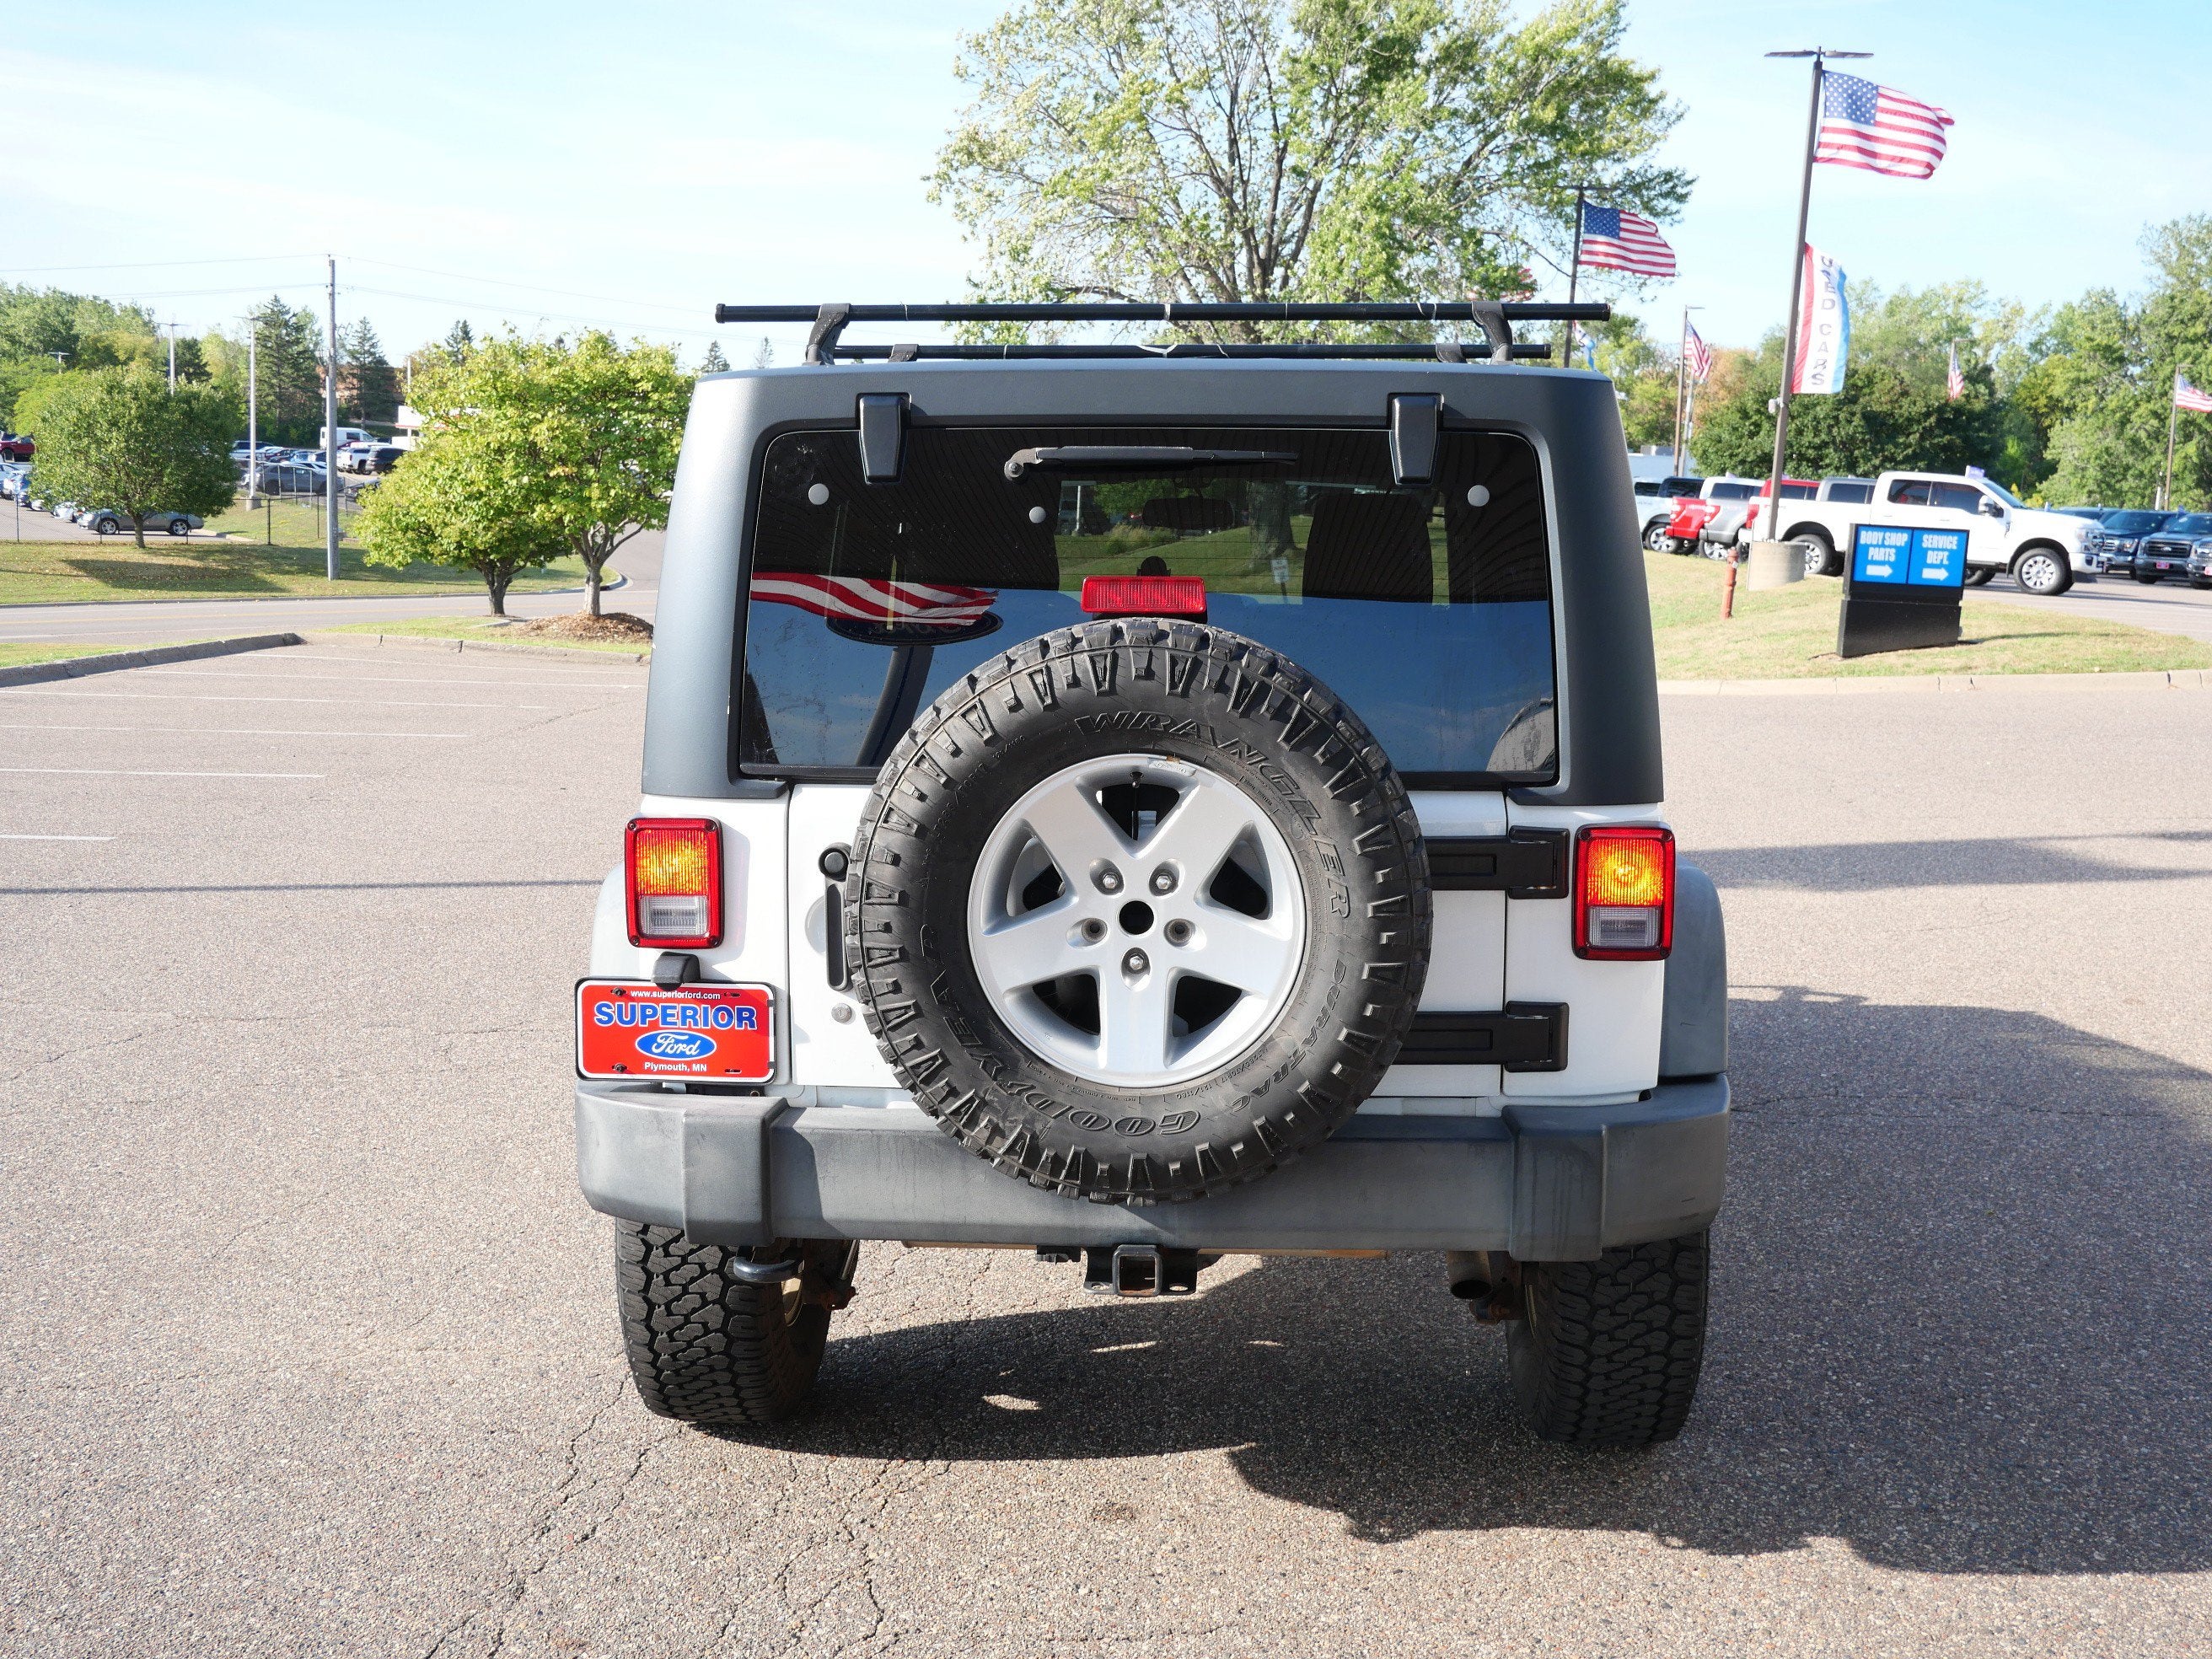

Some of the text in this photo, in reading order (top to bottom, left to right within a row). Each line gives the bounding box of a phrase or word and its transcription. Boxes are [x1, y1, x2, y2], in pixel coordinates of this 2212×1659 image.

[1812, 255, 1836, 386] USED CARS
[1860, 532, 1909, 546] BODY SHOP
[1922, 534, 1958, 550] SERVICE
[1868, 547, 1896, 561] PARTS
[1074, 710, 1350, 919] WRANGLER
[630, 989, 721, 1000] www.superiorford.com
[593, 1001, 758, 1031] SUPERIOR
[652, 1032, 701, 1055] Ford
[1231, 960, 1348, 1113] DURATRAC
[644, 1062, 707, 1072] Plymouth, MN
